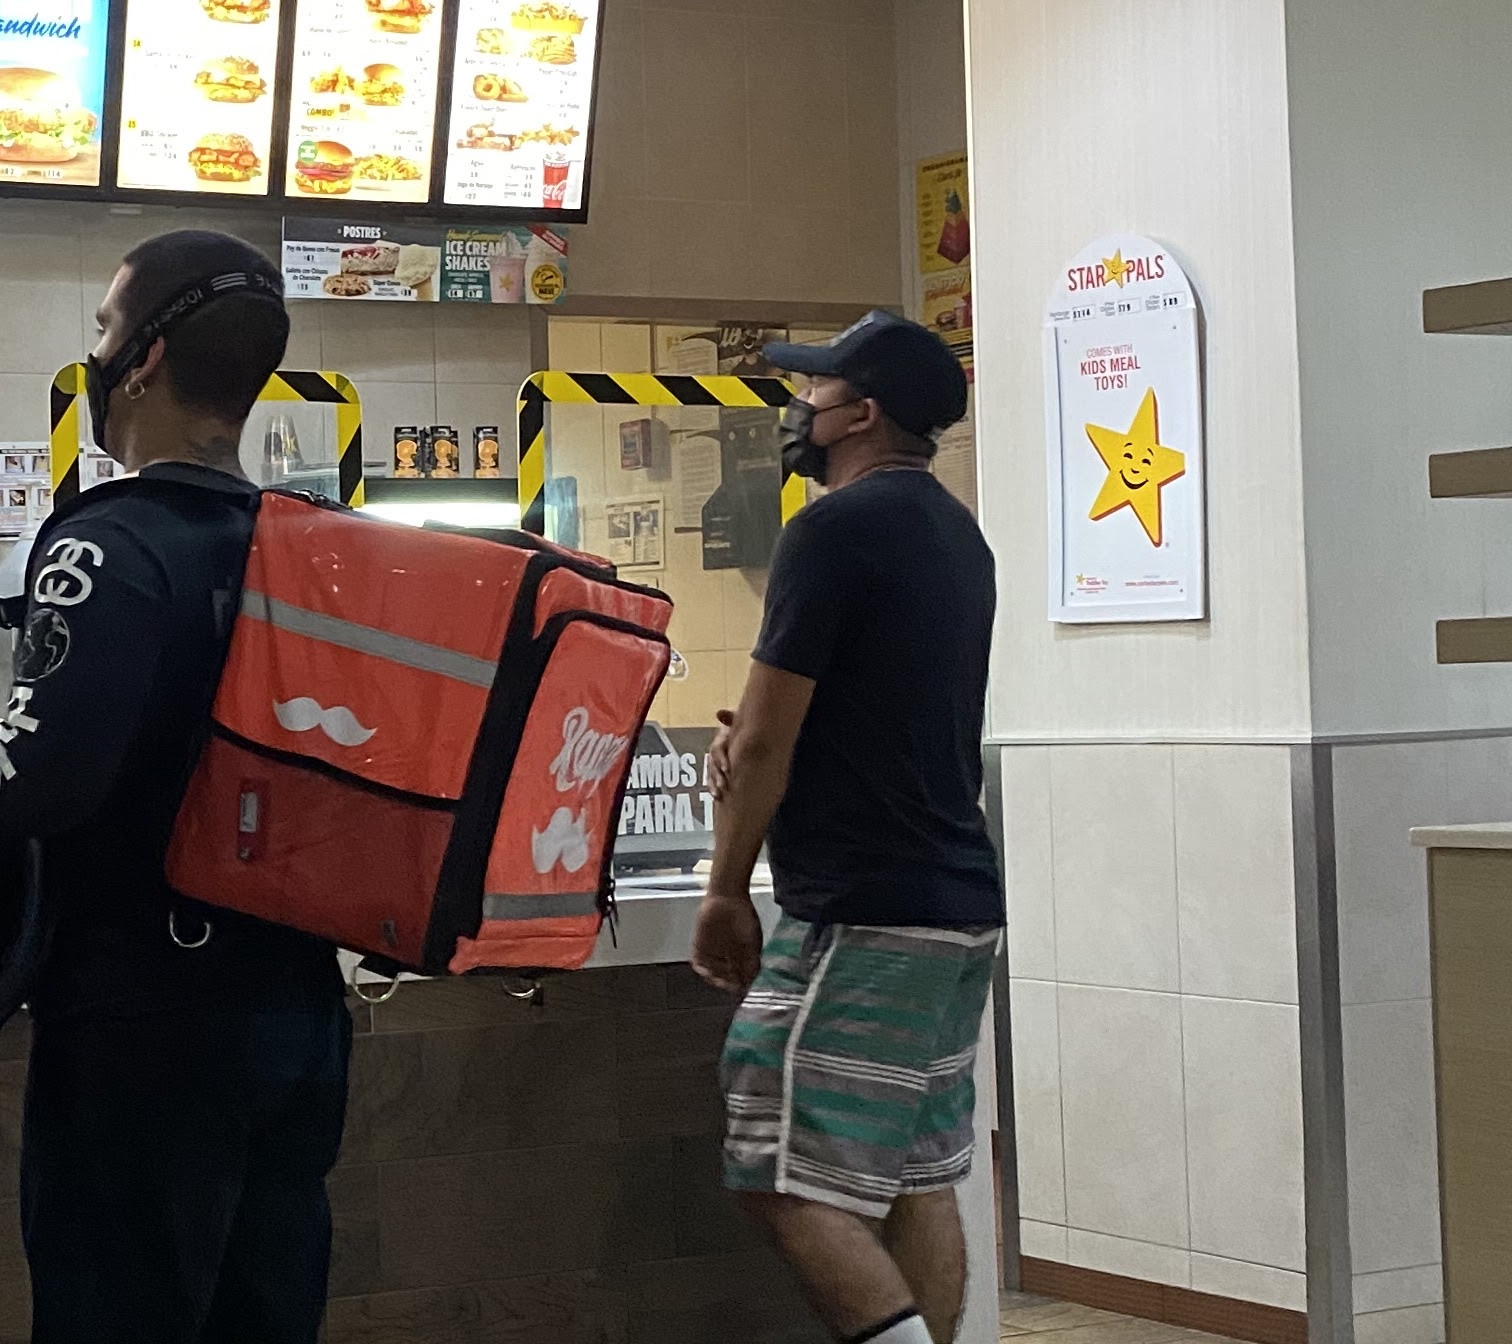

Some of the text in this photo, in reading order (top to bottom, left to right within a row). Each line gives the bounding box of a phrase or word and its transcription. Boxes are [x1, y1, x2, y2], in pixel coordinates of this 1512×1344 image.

[343, 225, 382, 239] POSTRES
[445, 240, 507, 256] ICE CREAM
[444, 255, 491, 272] SHAKES
[1067, 254, 1165, 292] STAR PALS
[1086, 343, 1134, 359] COMES WITH
[1080, 355, 1142, 376] KIDS MEAL
[1094, 374, 1129, 392] TOYS!
[626, 752, 698, 790] AMOS
[617, 792, 696, 836] PARA
